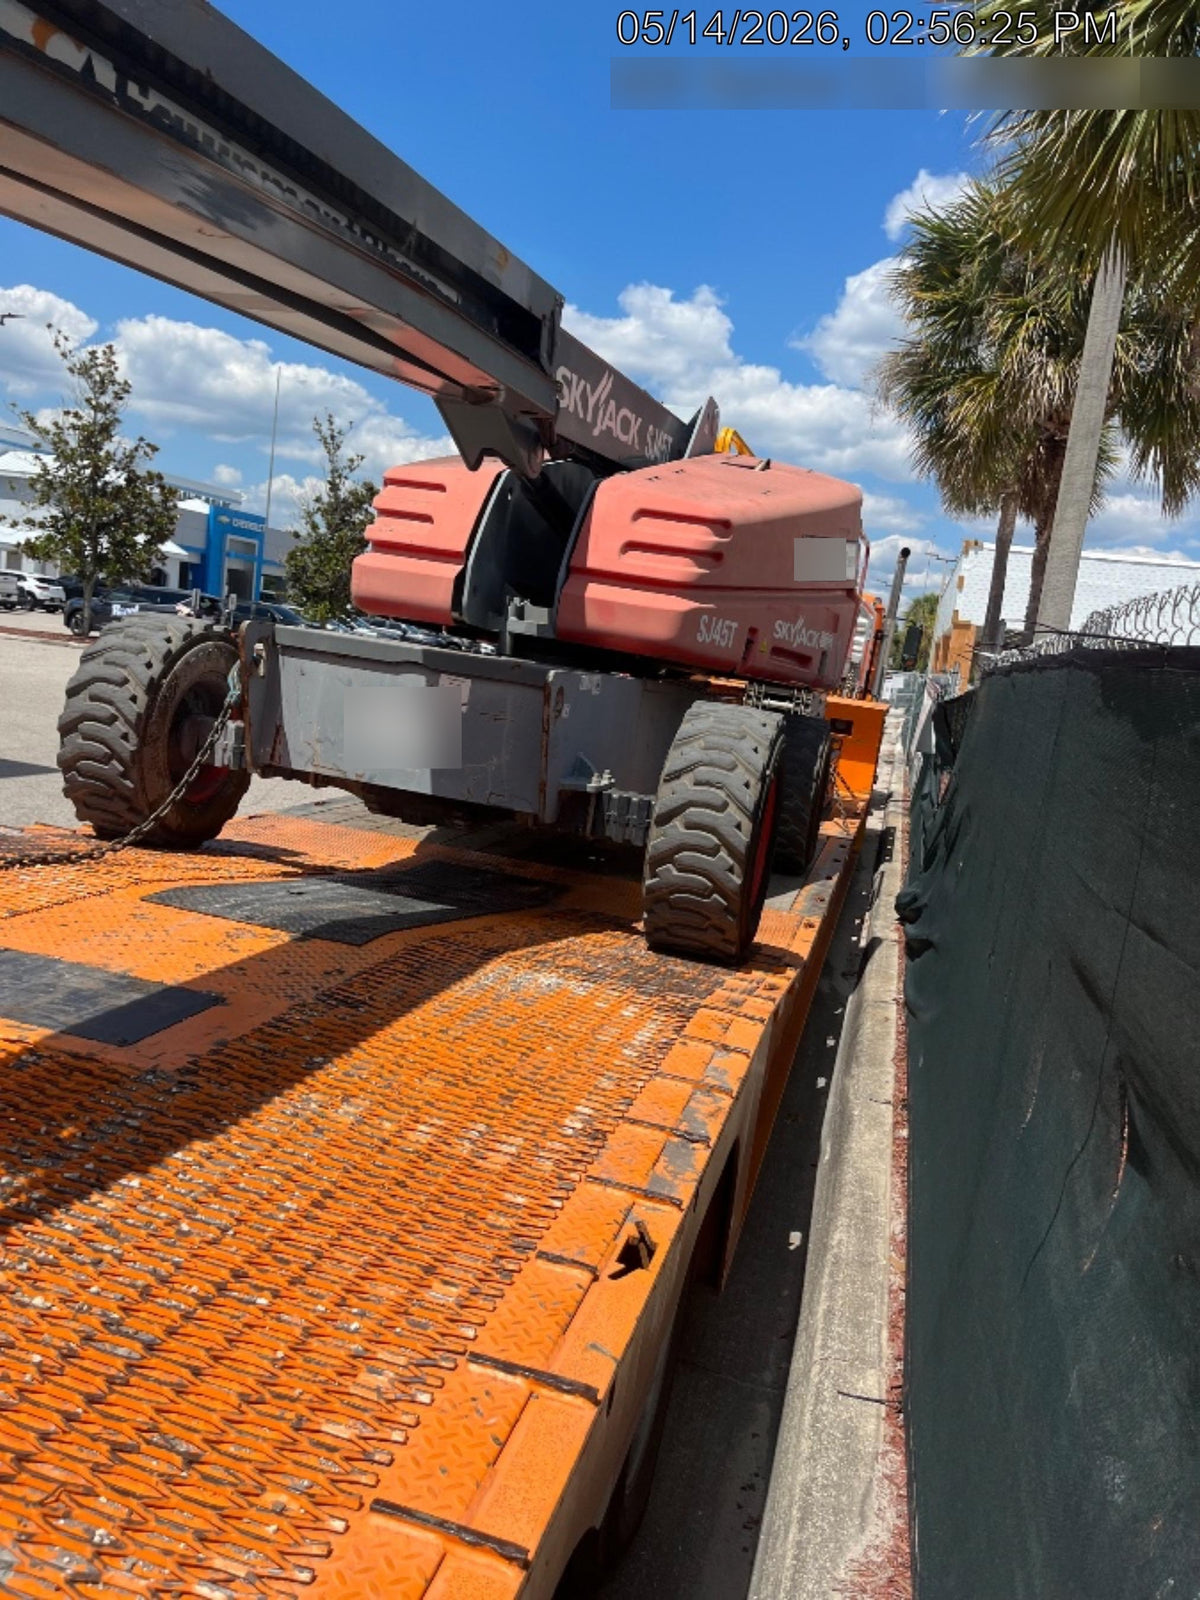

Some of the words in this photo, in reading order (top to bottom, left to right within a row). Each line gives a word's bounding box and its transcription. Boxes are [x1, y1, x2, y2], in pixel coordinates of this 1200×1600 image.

[556, 365, 642, 450] SKYJACK
[696, 614, 738, 648] SJ45T
[773, 616, 821, 649] SKYJACK
